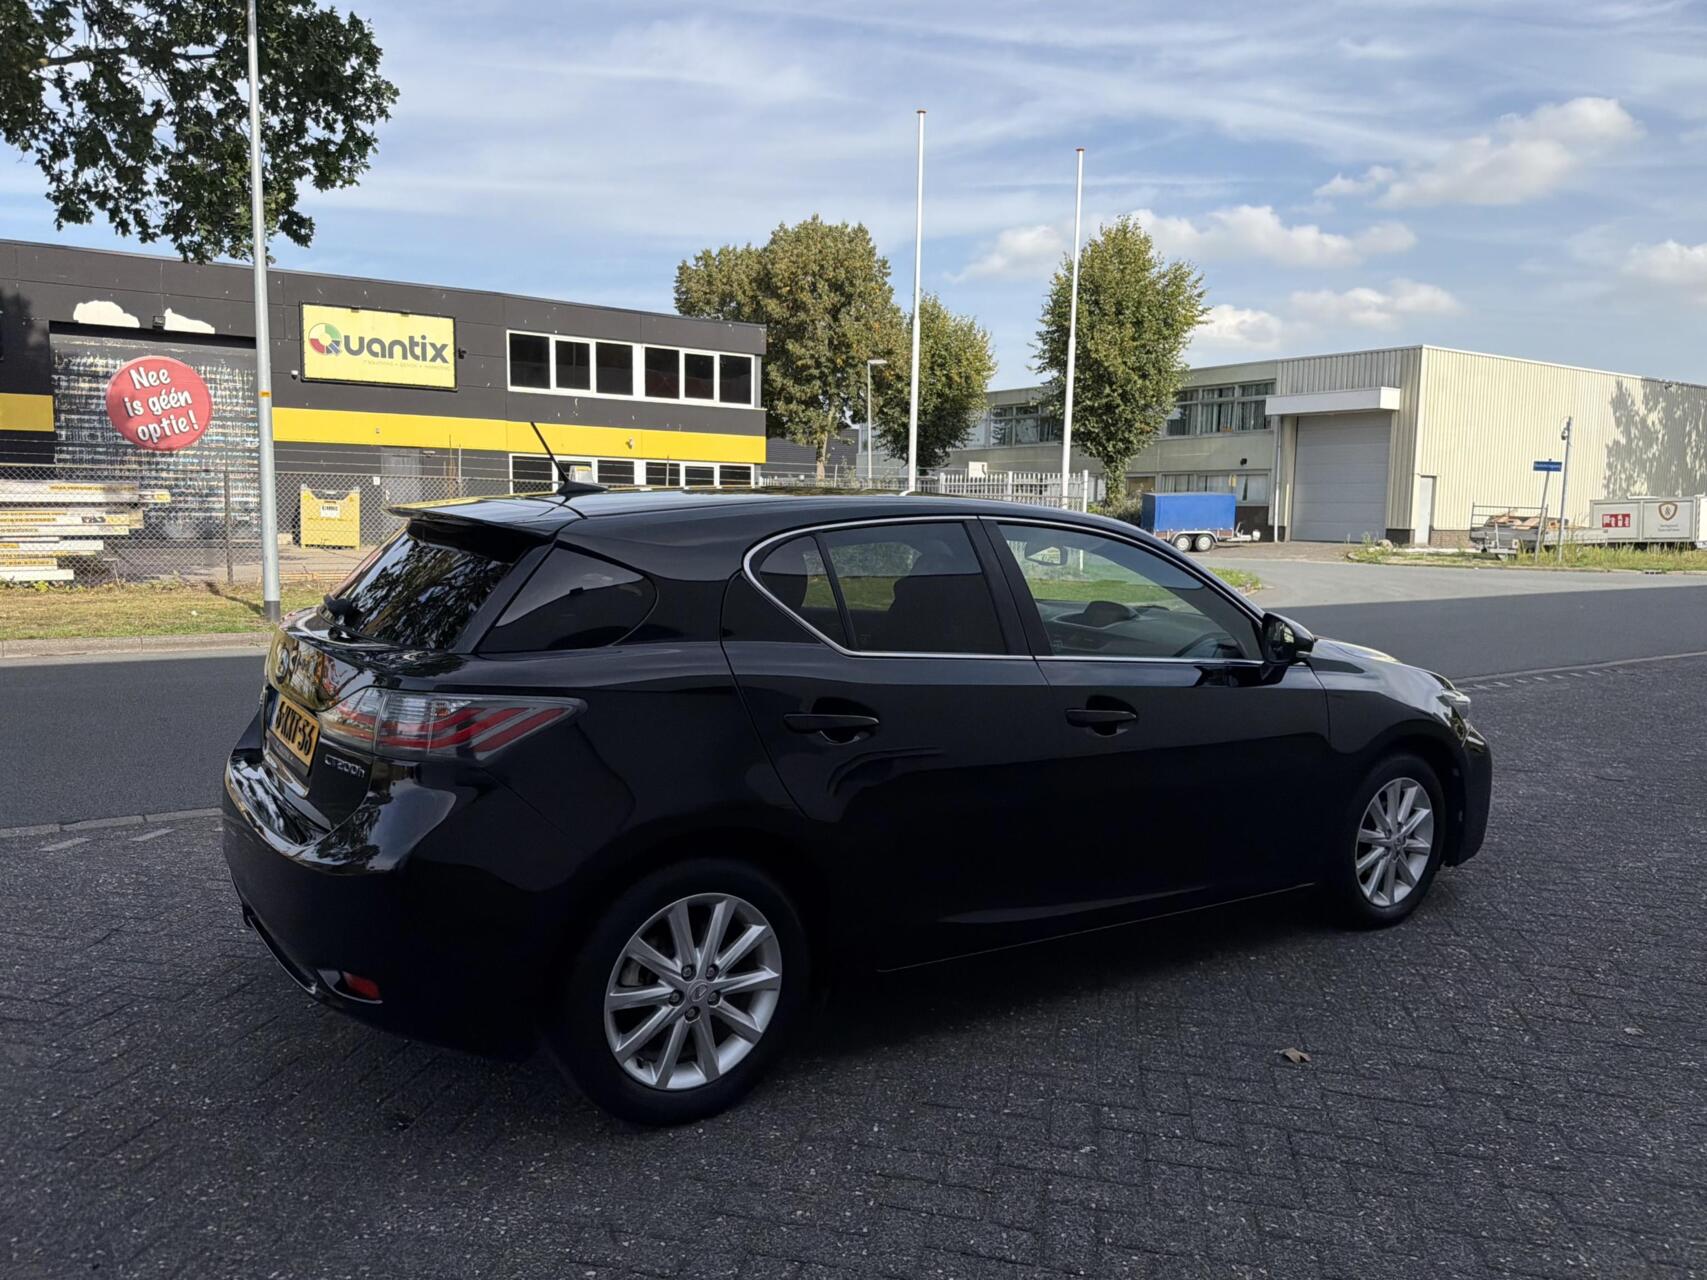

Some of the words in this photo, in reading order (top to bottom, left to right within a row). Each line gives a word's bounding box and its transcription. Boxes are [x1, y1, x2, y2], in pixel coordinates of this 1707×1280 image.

[308, 322, 450, 365] Quantix
[129, 366, 171, 390] Nee
[124, 396, 145, 418] is
[148, 386, 193, 416] géén
[137, 410, 199, 443] optie!
